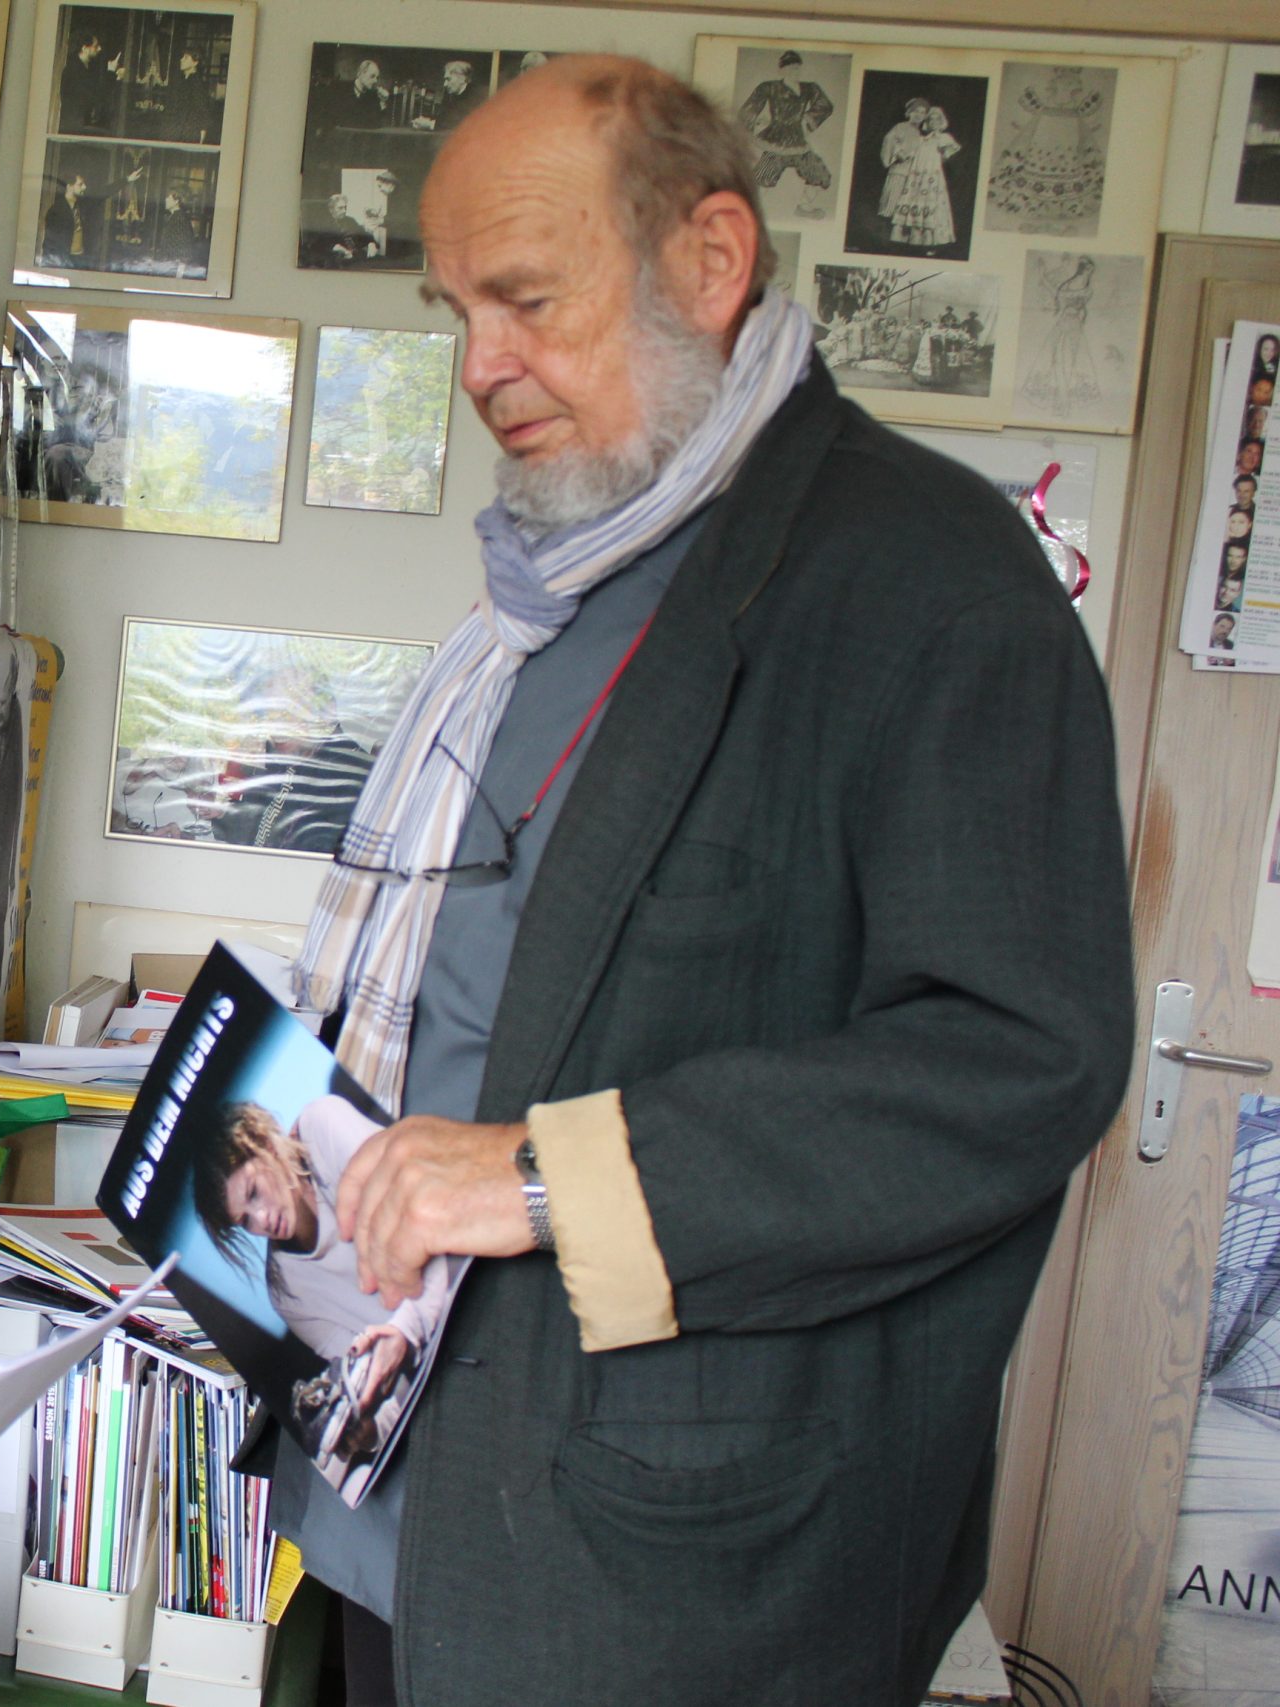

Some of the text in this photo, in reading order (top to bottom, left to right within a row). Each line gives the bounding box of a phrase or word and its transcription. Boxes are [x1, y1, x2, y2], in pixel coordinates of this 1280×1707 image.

[121, 991, 235, 1219] AUS DEM NICHTS
[44, 1408, 54, 1441] SAISON
